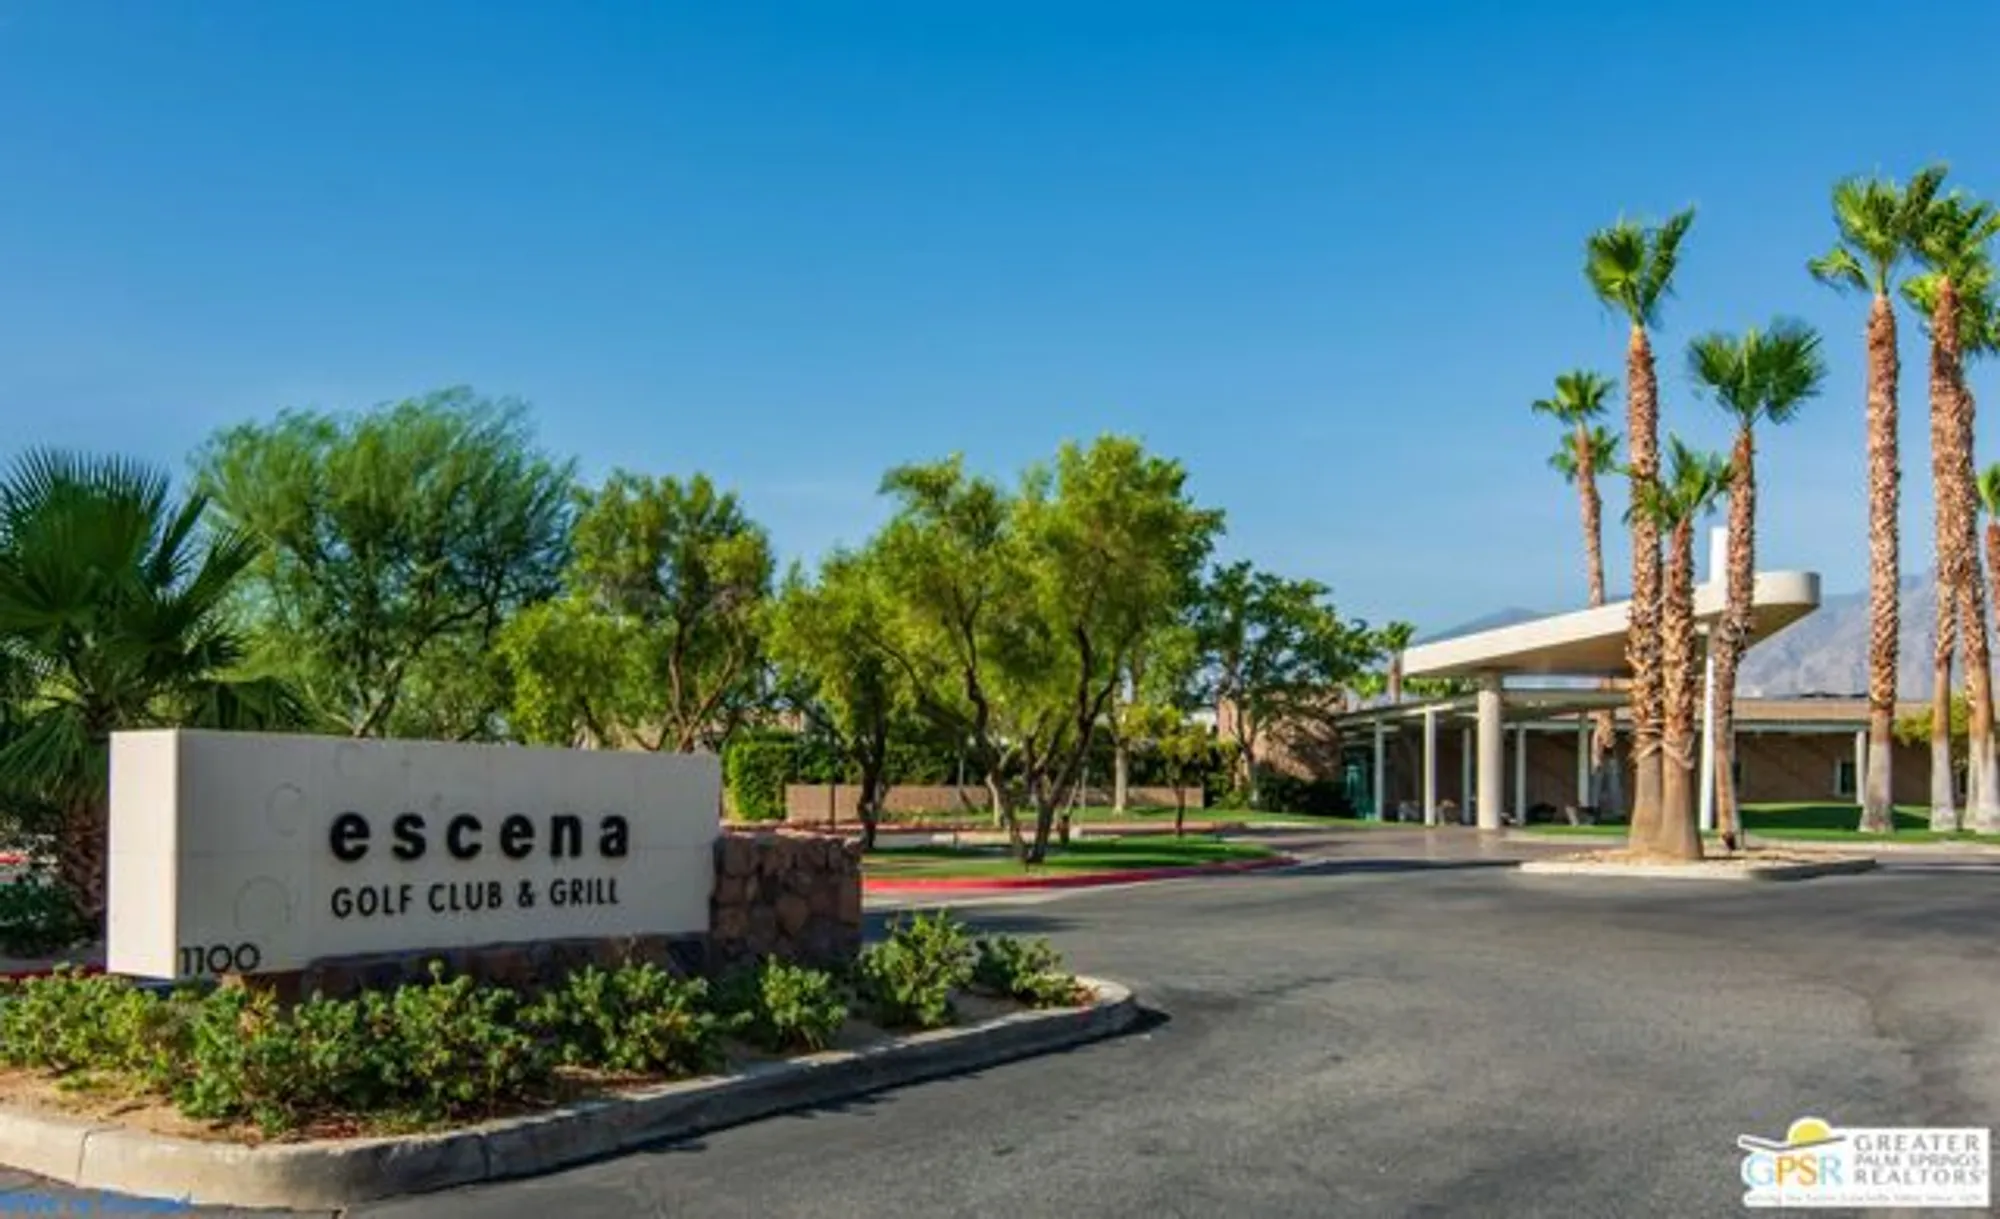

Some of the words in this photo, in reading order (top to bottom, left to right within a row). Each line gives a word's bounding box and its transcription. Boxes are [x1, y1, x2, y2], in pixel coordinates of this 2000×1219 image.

[329, 812, 630, 862] escena
[331, 884, 414, 918] GOLF
[428, 881, 503, 914] CLUB
[517, 879, 535, 908] &
[549, 876, 620, 906] GRILL
[180, 942, 261, 975] 1100
